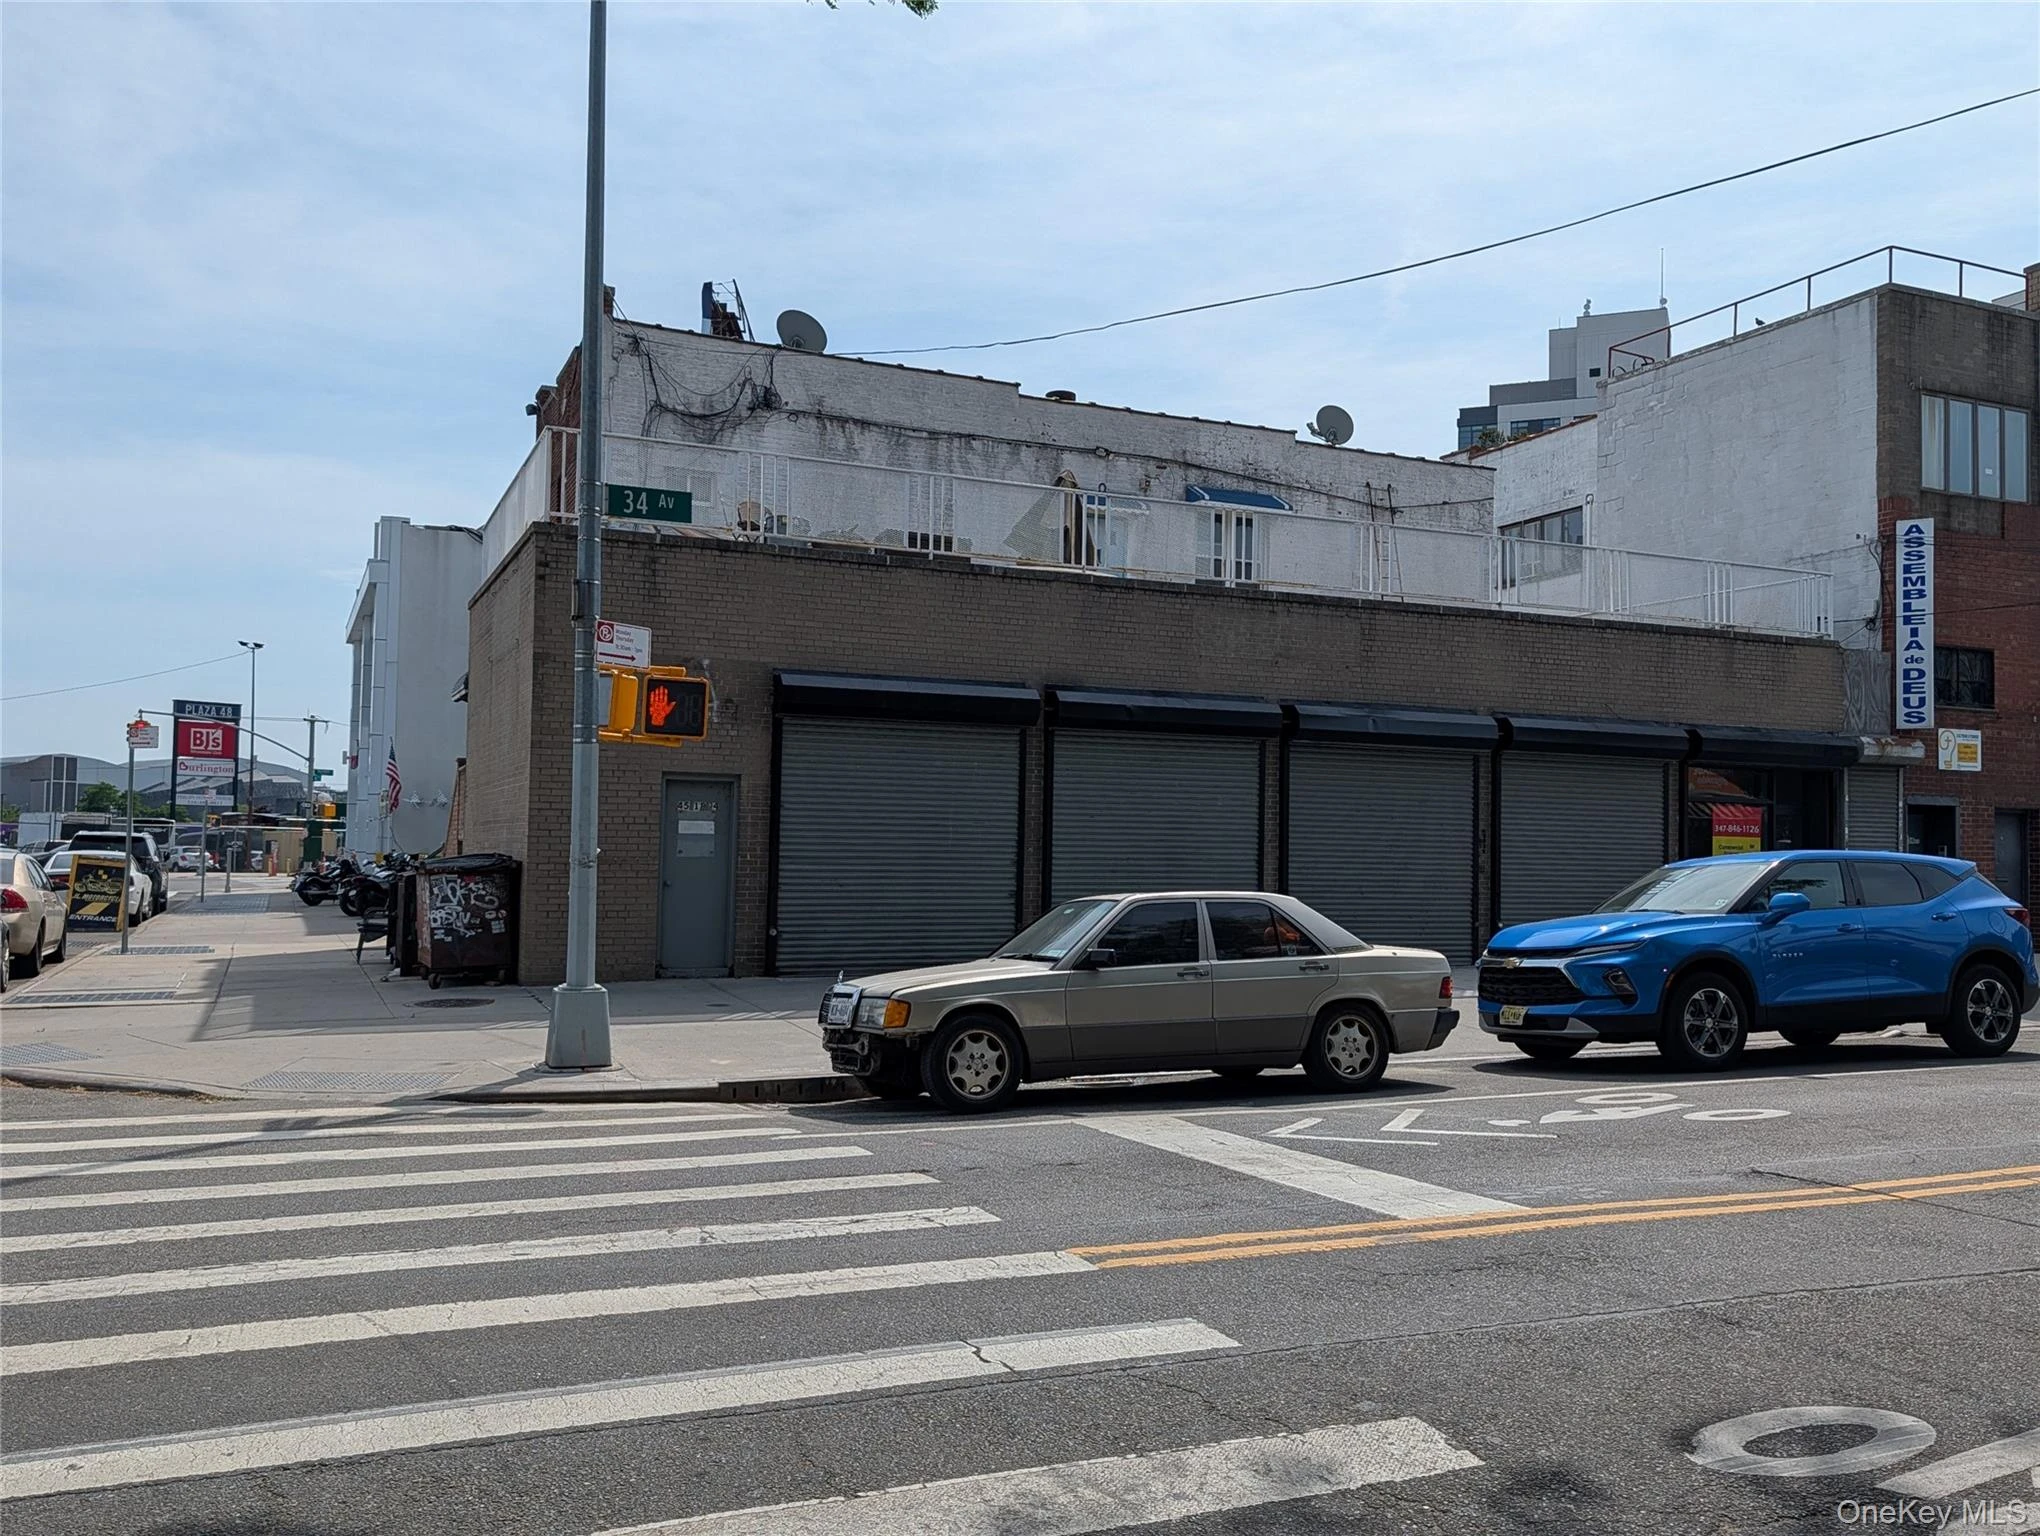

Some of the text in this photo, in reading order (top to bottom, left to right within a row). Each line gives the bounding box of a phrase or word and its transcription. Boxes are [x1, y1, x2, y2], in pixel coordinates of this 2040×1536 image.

[623, 489, 675, 515] 34 Av
[1903, 523, 1927, 651] ASSEMBLEIA
[1904, 654, 1925, 665] de
[1902, 668, 1927, 725] DEUS
[185, 703, 233, 718] PLAZA 48
[179, 761, 234, 774] Burlington
[68, 913, 118, 923] ENTRANCE
